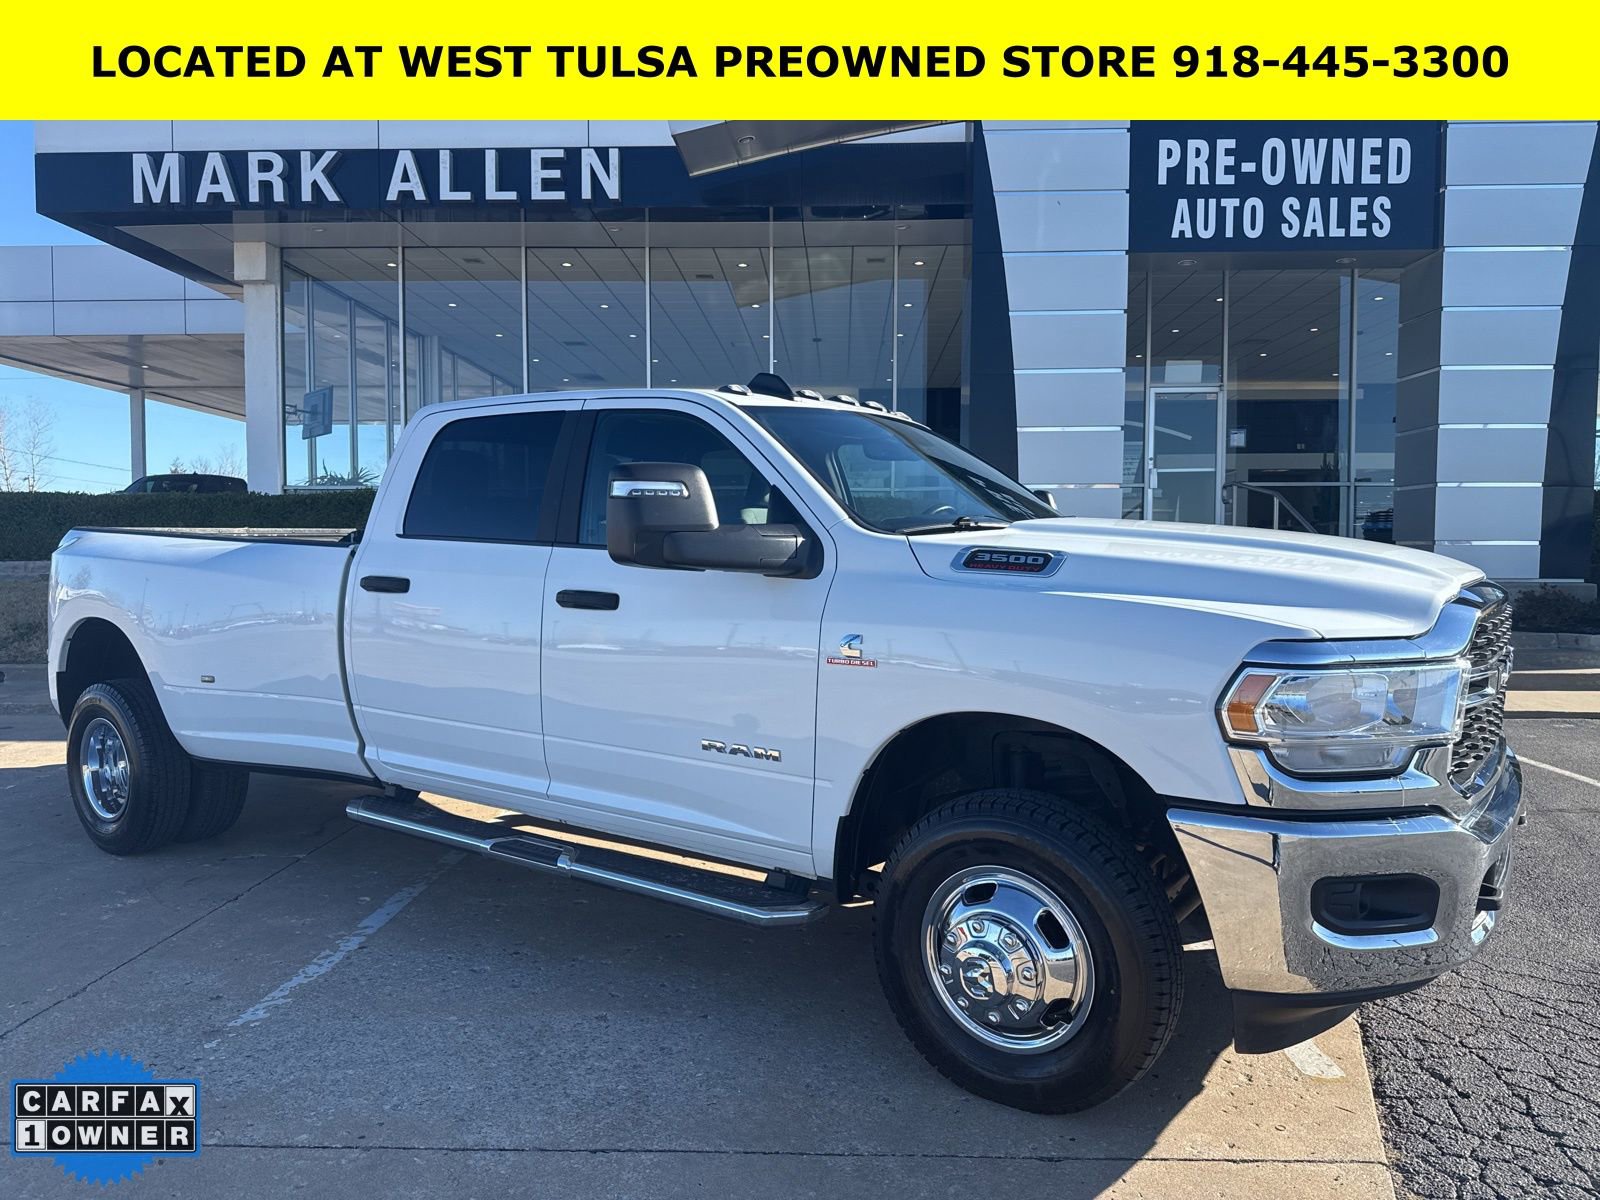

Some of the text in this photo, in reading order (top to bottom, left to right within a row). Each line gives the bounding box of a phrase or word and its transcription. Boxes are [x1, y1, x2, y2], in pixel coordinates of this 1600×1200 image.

[132, 147, 621, 205] MARK ALLEN
[1157, 137, 1412, 186] PRE-OWNED
[1170, 195, 1392, 239] AUTO SALES
[969, 562, 1041, 572] HEAVY DUTY
[974, 552, 1044, 565] 3500
[701, 738, 782, 763] RAM
